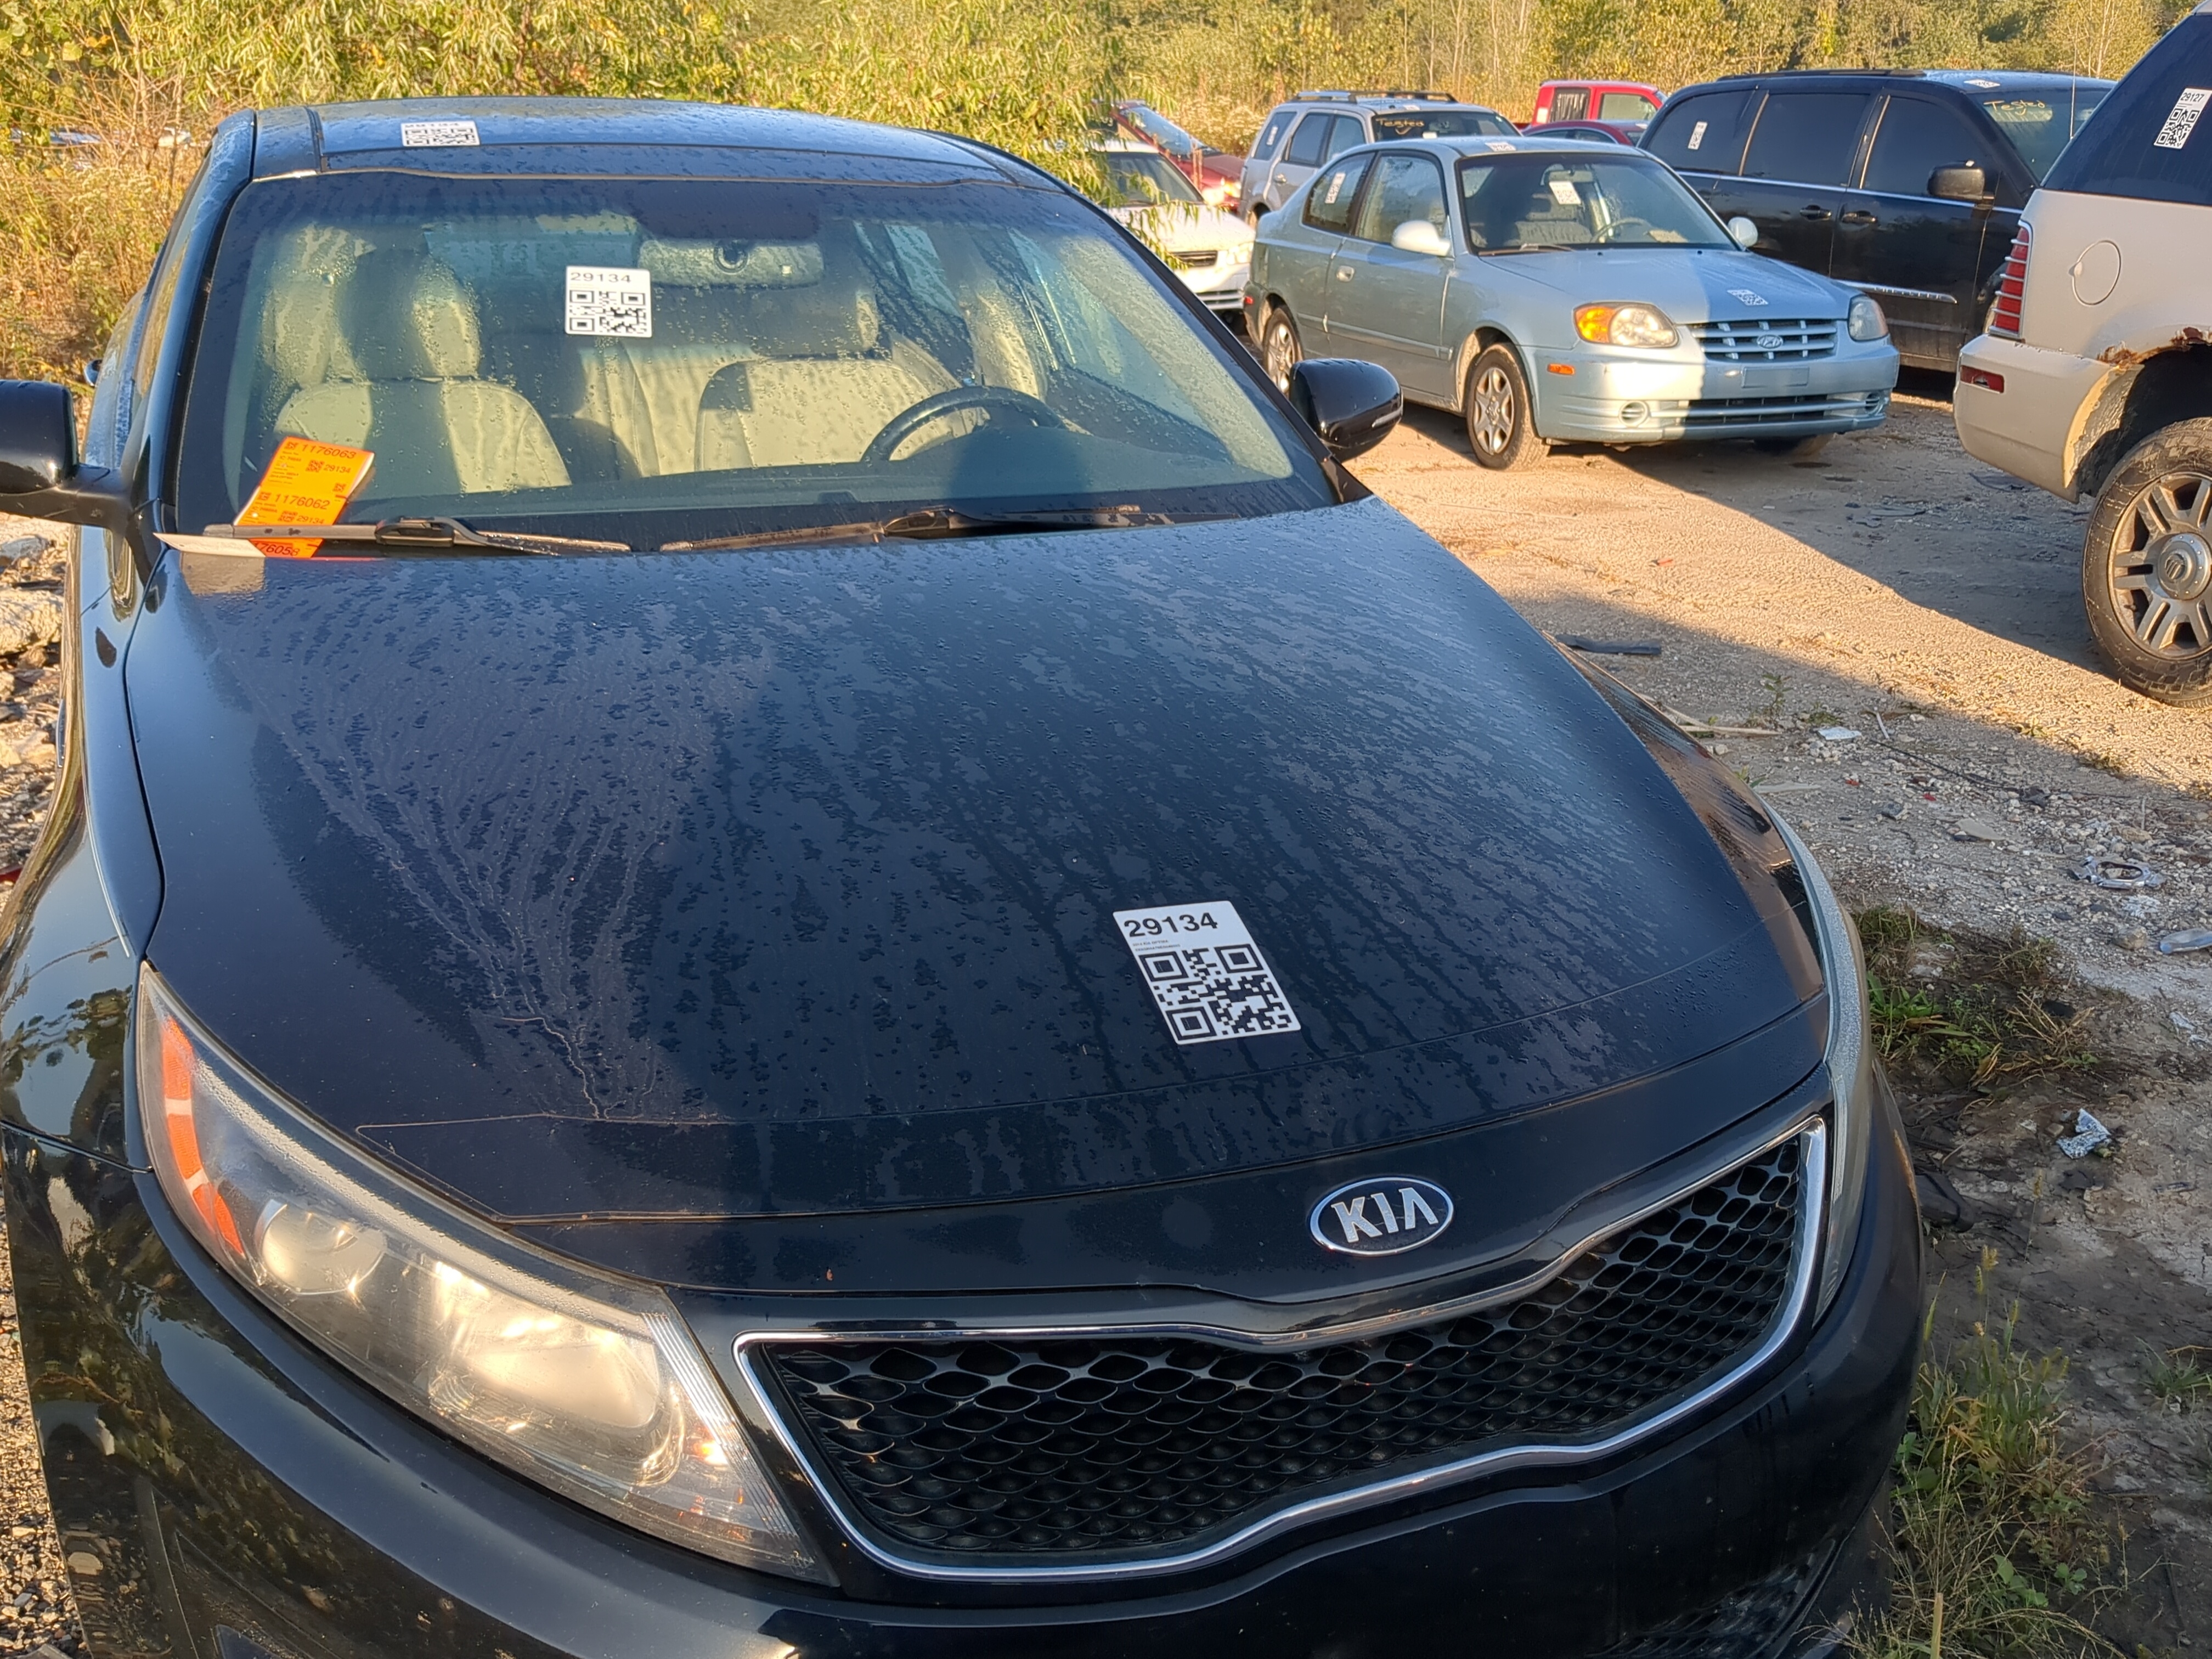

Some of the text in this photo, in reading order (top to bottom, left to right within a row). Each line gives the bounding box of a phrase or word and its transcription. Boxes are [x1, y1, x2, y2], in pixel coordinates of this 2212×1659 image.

[2180, 92, 2205, 103] 29127
[1983, 100, 2045, 111] Tested
[571, 272, 631, 283] 29134
[302, 444, 357, 459] 1176063
[324, 464, 352, 473] 29134
[275, 494, 330, 510] 1176062
[296, 515, 325, 524] 29134
[1124, 912, 1218, 938] 29134
[1330, 1187, 1438, 1243] KIA
